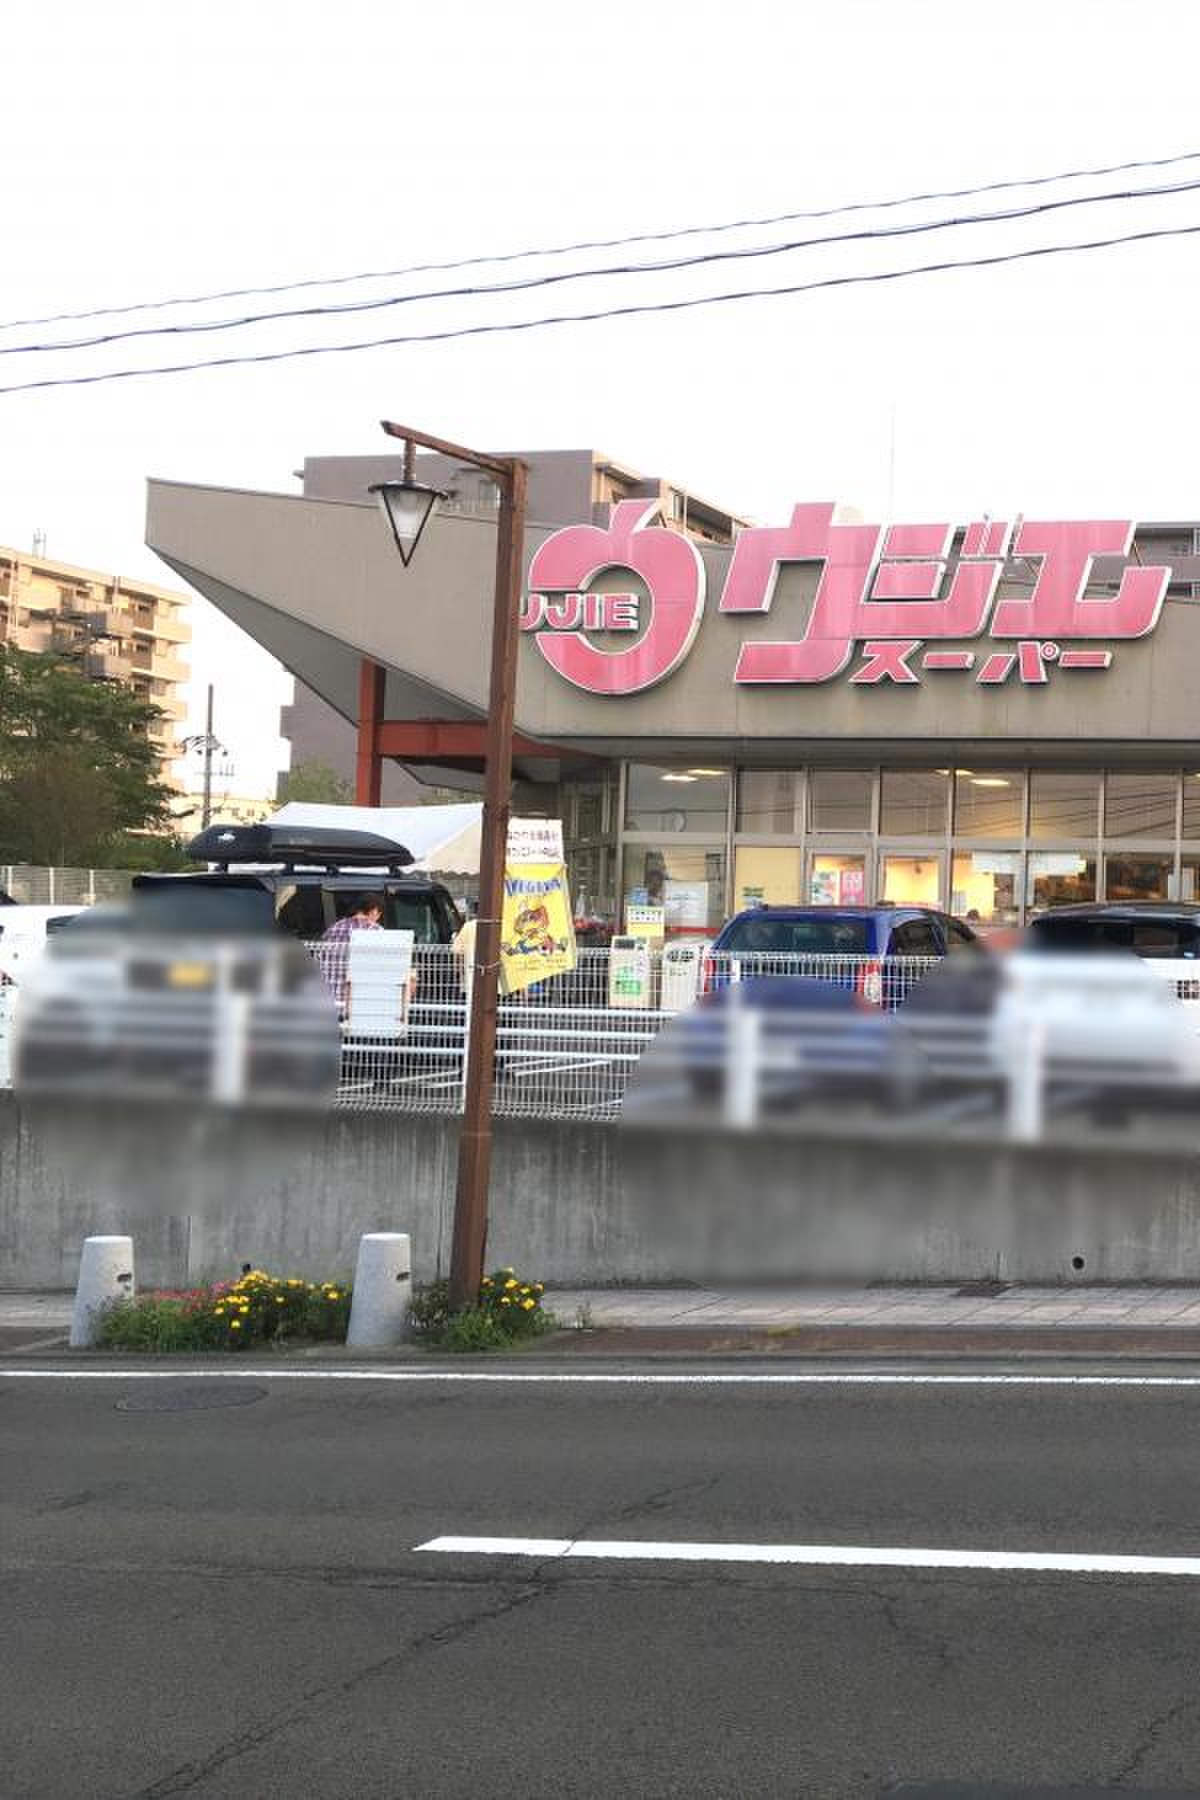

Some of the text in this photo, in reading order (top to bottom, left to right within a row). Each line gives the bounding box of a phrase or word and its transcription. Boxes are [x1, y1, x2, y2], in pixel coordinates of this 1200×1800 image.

[719, 501, 1172, 684] ウジエ
[848, 640, 1112, 684] スーパー
